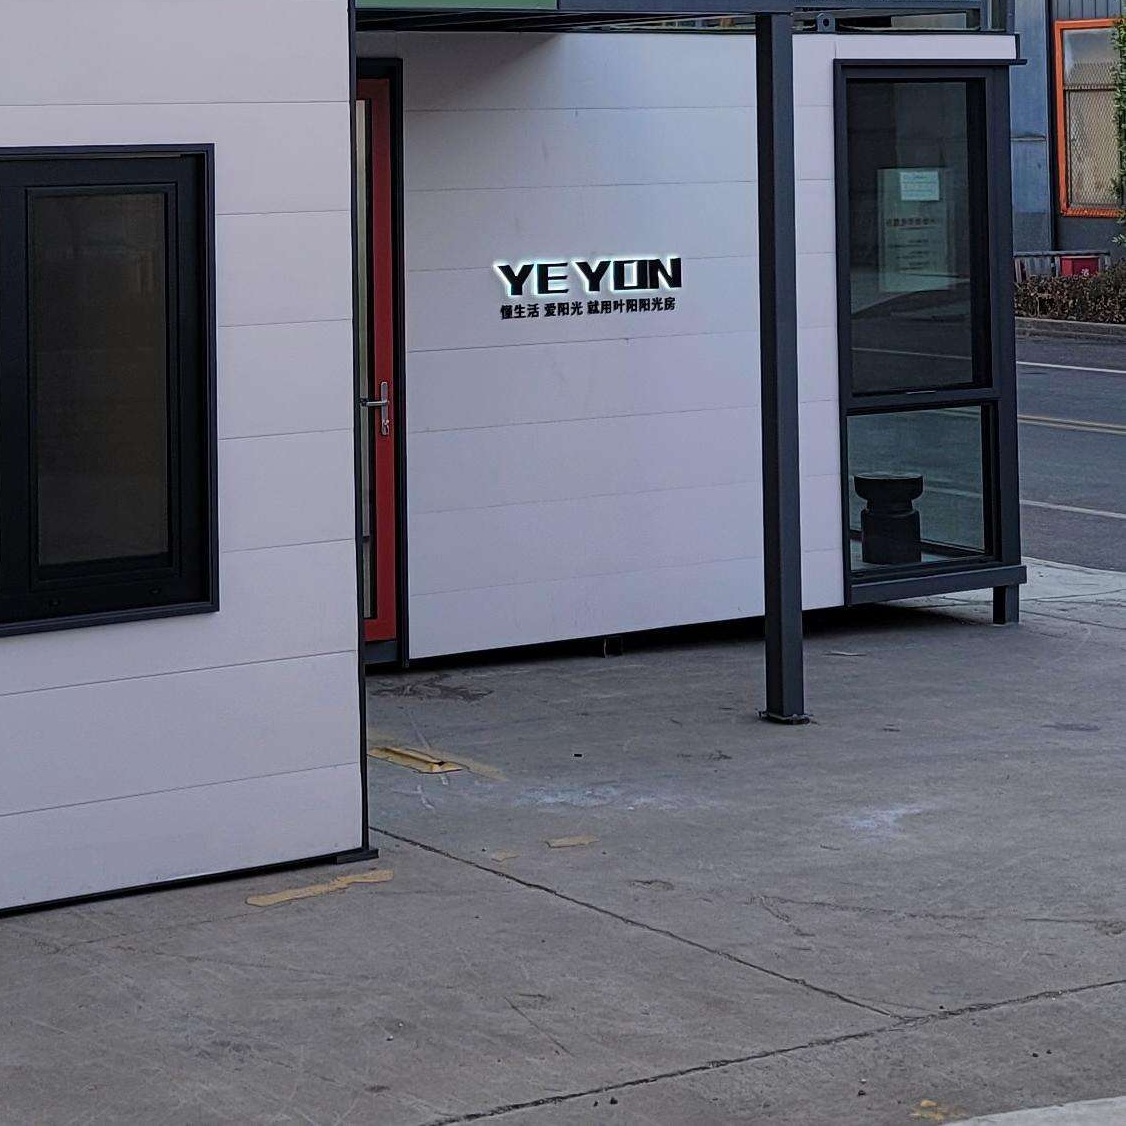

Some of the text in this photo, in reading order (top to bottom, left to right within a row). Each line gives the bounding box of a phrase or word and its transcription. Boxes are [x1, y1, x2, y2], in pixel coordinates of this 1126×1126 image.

[496, 257, 683, 296] YEYON
[500, 297, 676, 320] 懂生活 爱阳光 就用叶阳阳光房
